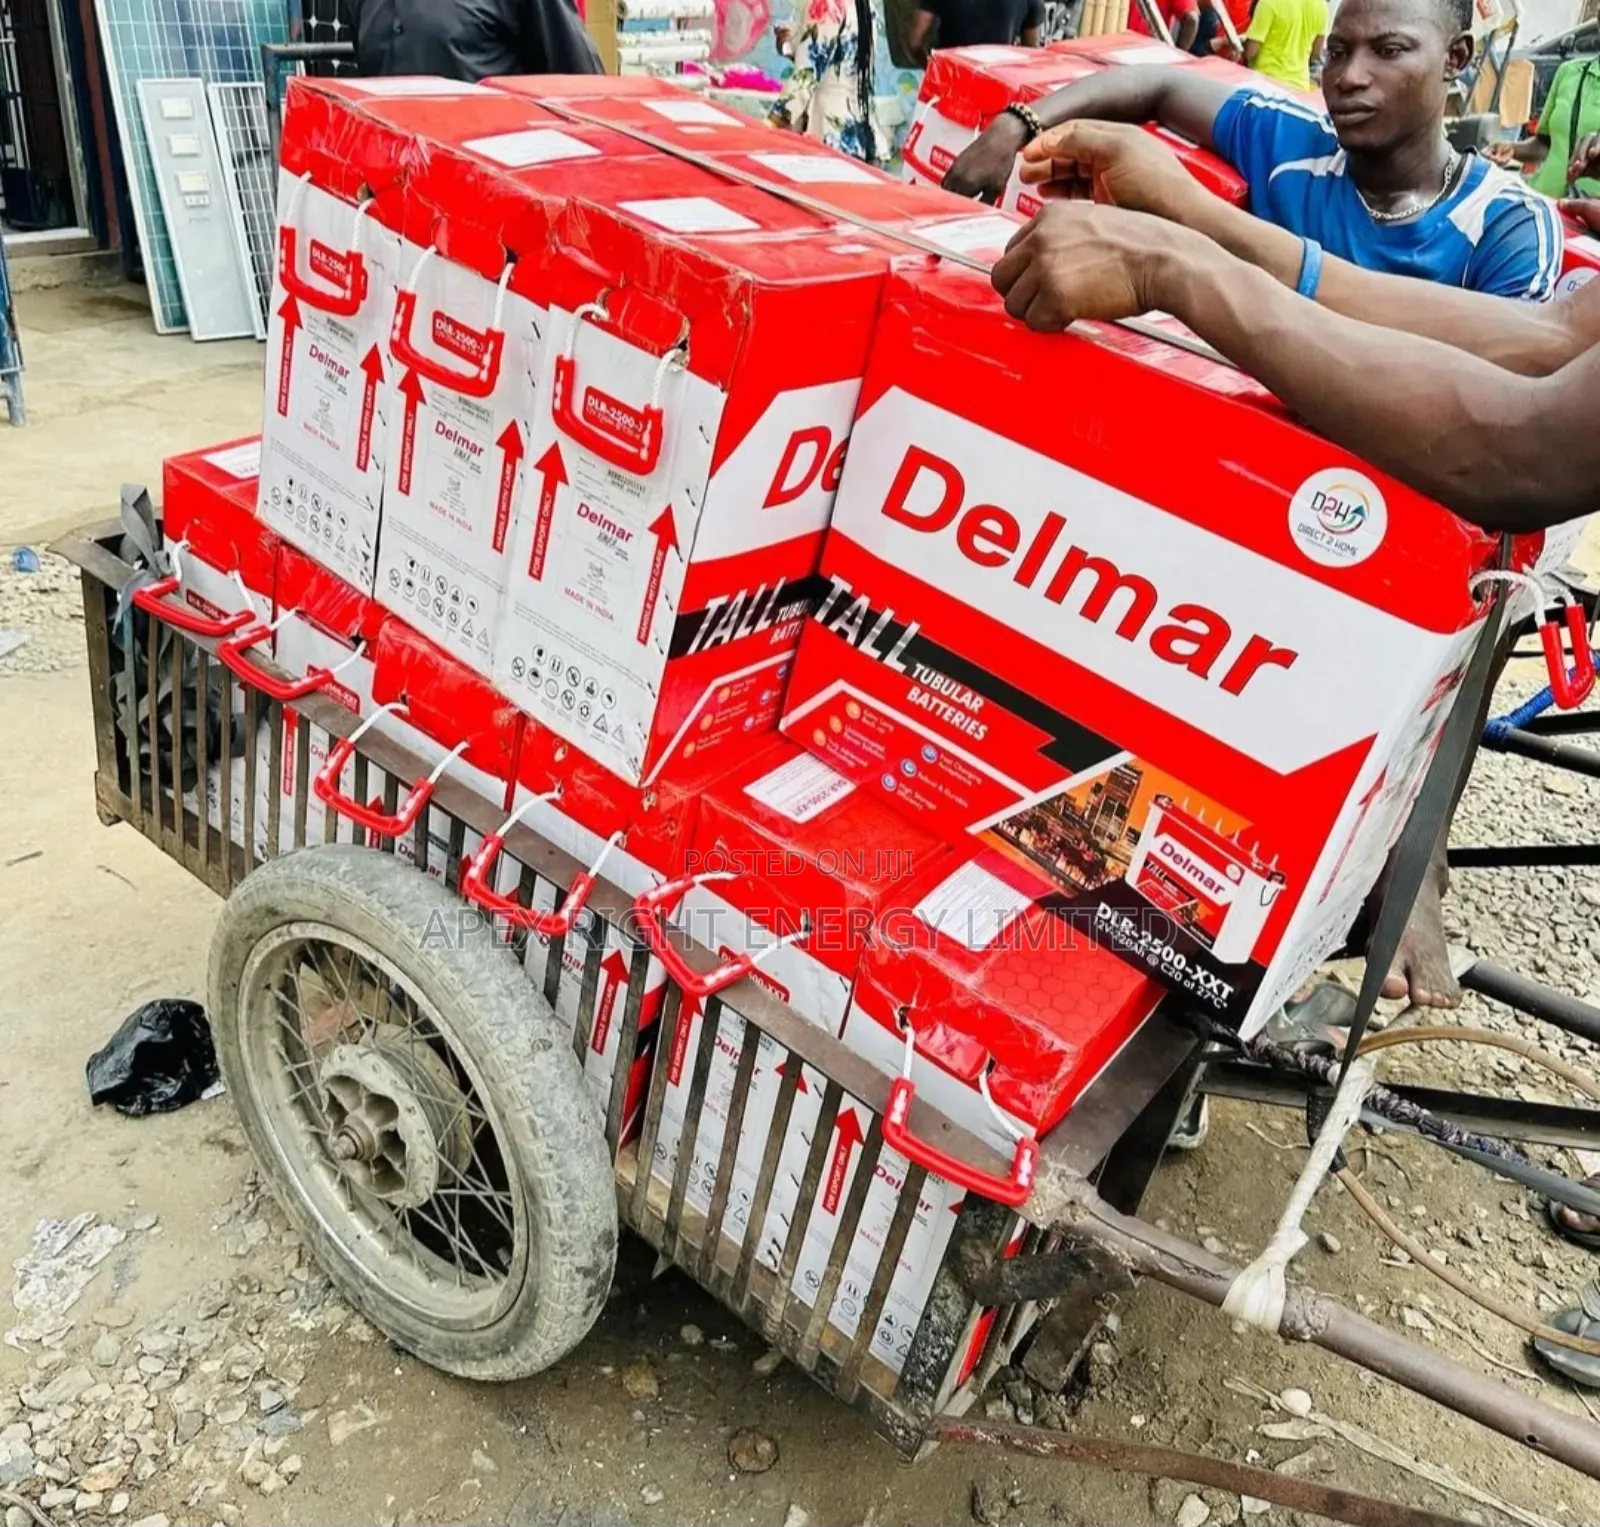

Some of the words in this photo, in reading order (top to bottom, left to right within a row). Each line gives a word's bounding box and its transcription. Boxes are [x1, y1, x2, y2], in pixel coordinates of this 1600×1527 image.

[281, 360, 289, 393] EXPORT
[309, 344, 350, 379] Delmar
[406, 412, 414, 436] ONLY
[435, 420, 484, 457] Delmar
[402, 437, 412, 471] EXPORT
[503, 462, 513, 488] CARE
[501, 489, 510, 512] WITH
[542, 491, 552, 517] ONLY
[1311, 491, 1351, 521] D2H
[495, 513, 507, 549] HANDLE
[535, 518, 548, 555] EXPORT
[577, 502, 633, 542] Delmar
[1297, 522, 1326, 541] DIRECT
[1335, 540, 1358, 556] HOME
[532, 556, 541, 576] FOR
[881, 444, 1299, 697] Delmar
[564, 587, 585, 604] MADE
[594, 603, 614, 621] INDIA
[638, 602, 652, 640] HANDLE
[647, 576, 658, 601] WITH
[653, 549, 664, 576] CARE
[686, 577, 787, 656] TALL
[814, 573, 921, 673] TALL
[912, 663, 984, 714] TUBULAR
[906, 686, 988, 741] BATTERIES
[1160, 841, 1225, 894] Delmar
[1097, 901, 1234, 1001] DLR-2500-XXT
[1146, 953, 1159, 967] @
[1160, 962, 1183, 982] C20
[594, 1023, 606, 1050] HANDLE
[600, 1004, 610, 1022] WITH
[605, 983, 615, 1004] CARE
[679, 1017, 689, 1037] ONLY
[673, 1038, 684, 1065] EXPORT
[670, 1066, 679, 1082] FOR
[836, 1144, 848, 1166] ONLY
[829, 1167, 843, 1194] EXPORT
[826, 1194, 835, 1210] FOR
